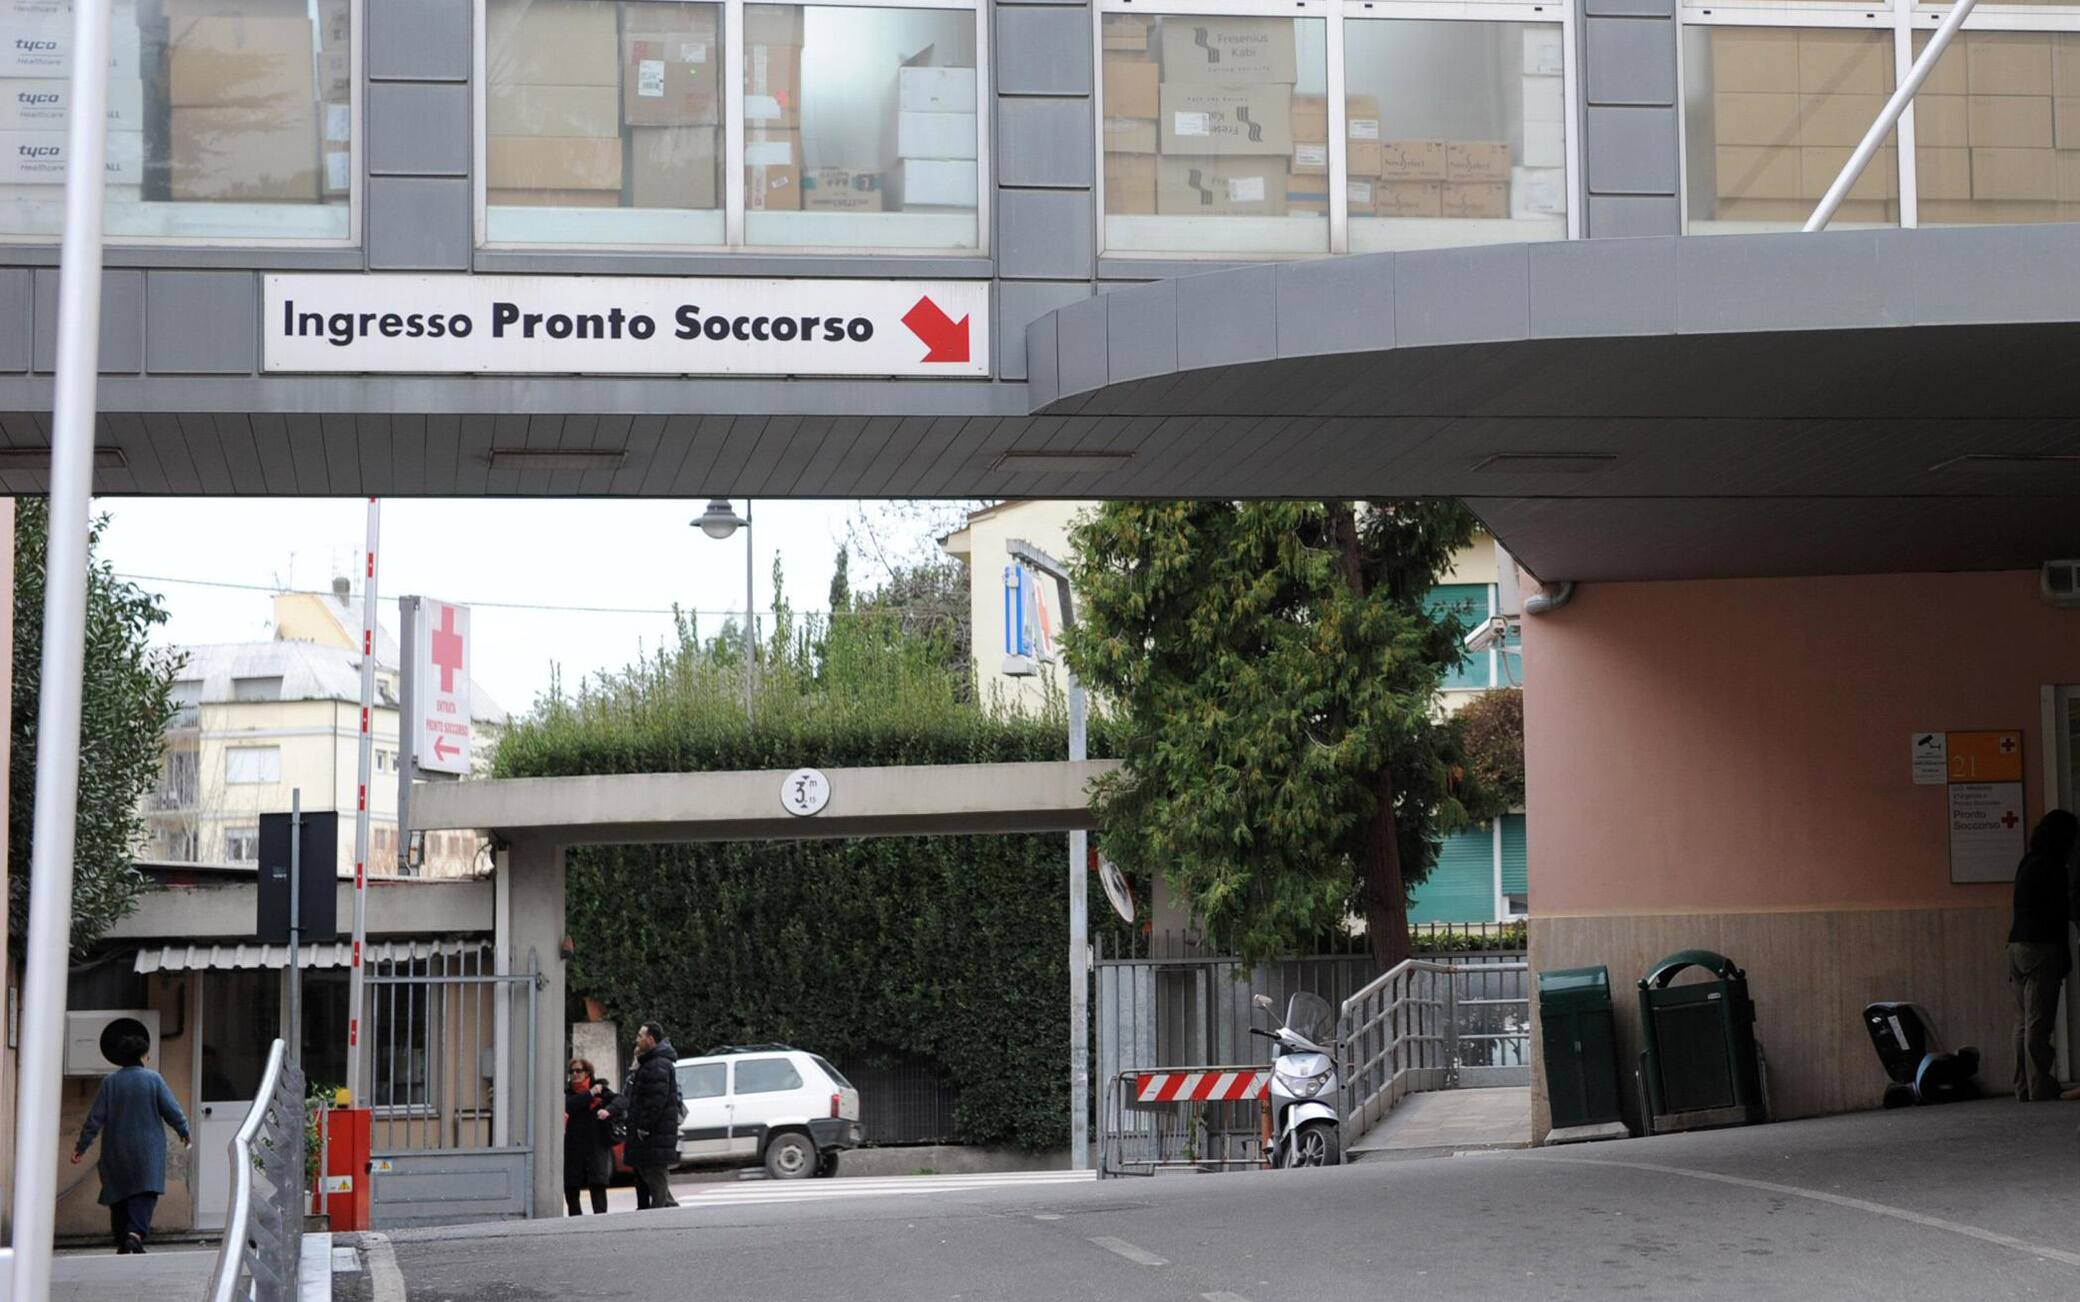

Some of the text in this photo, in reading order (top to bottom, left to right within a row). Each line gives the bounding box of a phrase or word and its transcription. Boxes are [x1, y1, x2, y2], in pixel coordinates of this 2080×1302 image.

[1217, 32, 1269, 44] Fresenius
[15, 39, 57, 52] tyco
[1231, 47, 1257, 58] Kabi
[17, 92, 59, 105] tyco
[18, 144, 60, 158] tyco
[284, 300, 874, 347] Ingresso Pronto Soccorso
[444, 722, 469, 737] SOCCORSO
[1952, 755, 1976, 777] 21
[1953, 809, 1987, 819] Pronto
[1953, 820, 2001, 831] Soccorso
